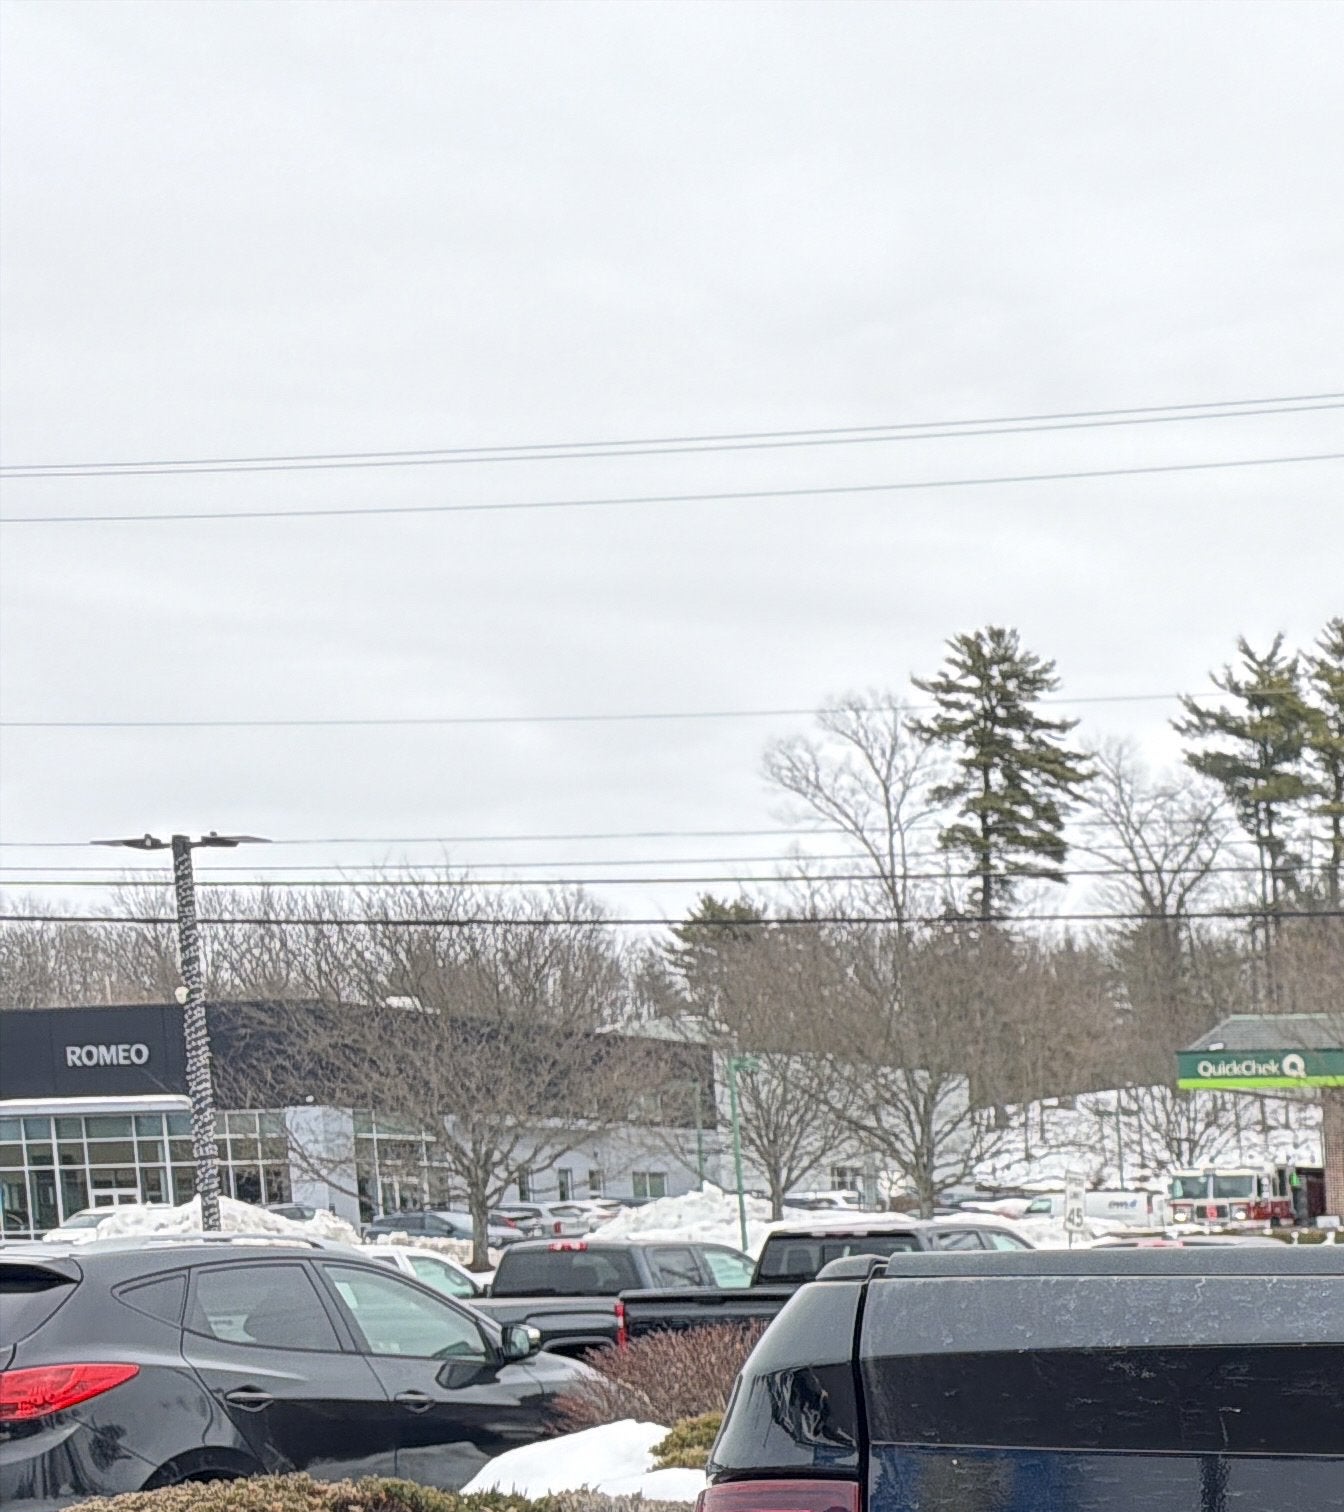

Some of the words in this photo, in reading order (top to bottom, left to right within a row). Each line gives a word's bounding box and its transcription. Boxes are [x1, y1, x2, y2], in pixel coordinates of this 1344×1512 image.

[66, 1043, 149, 1067] ROMEO
[1198, 1060, 1280, 1077] QuickChek
[1068, 1207, 1083, 1227] 45
